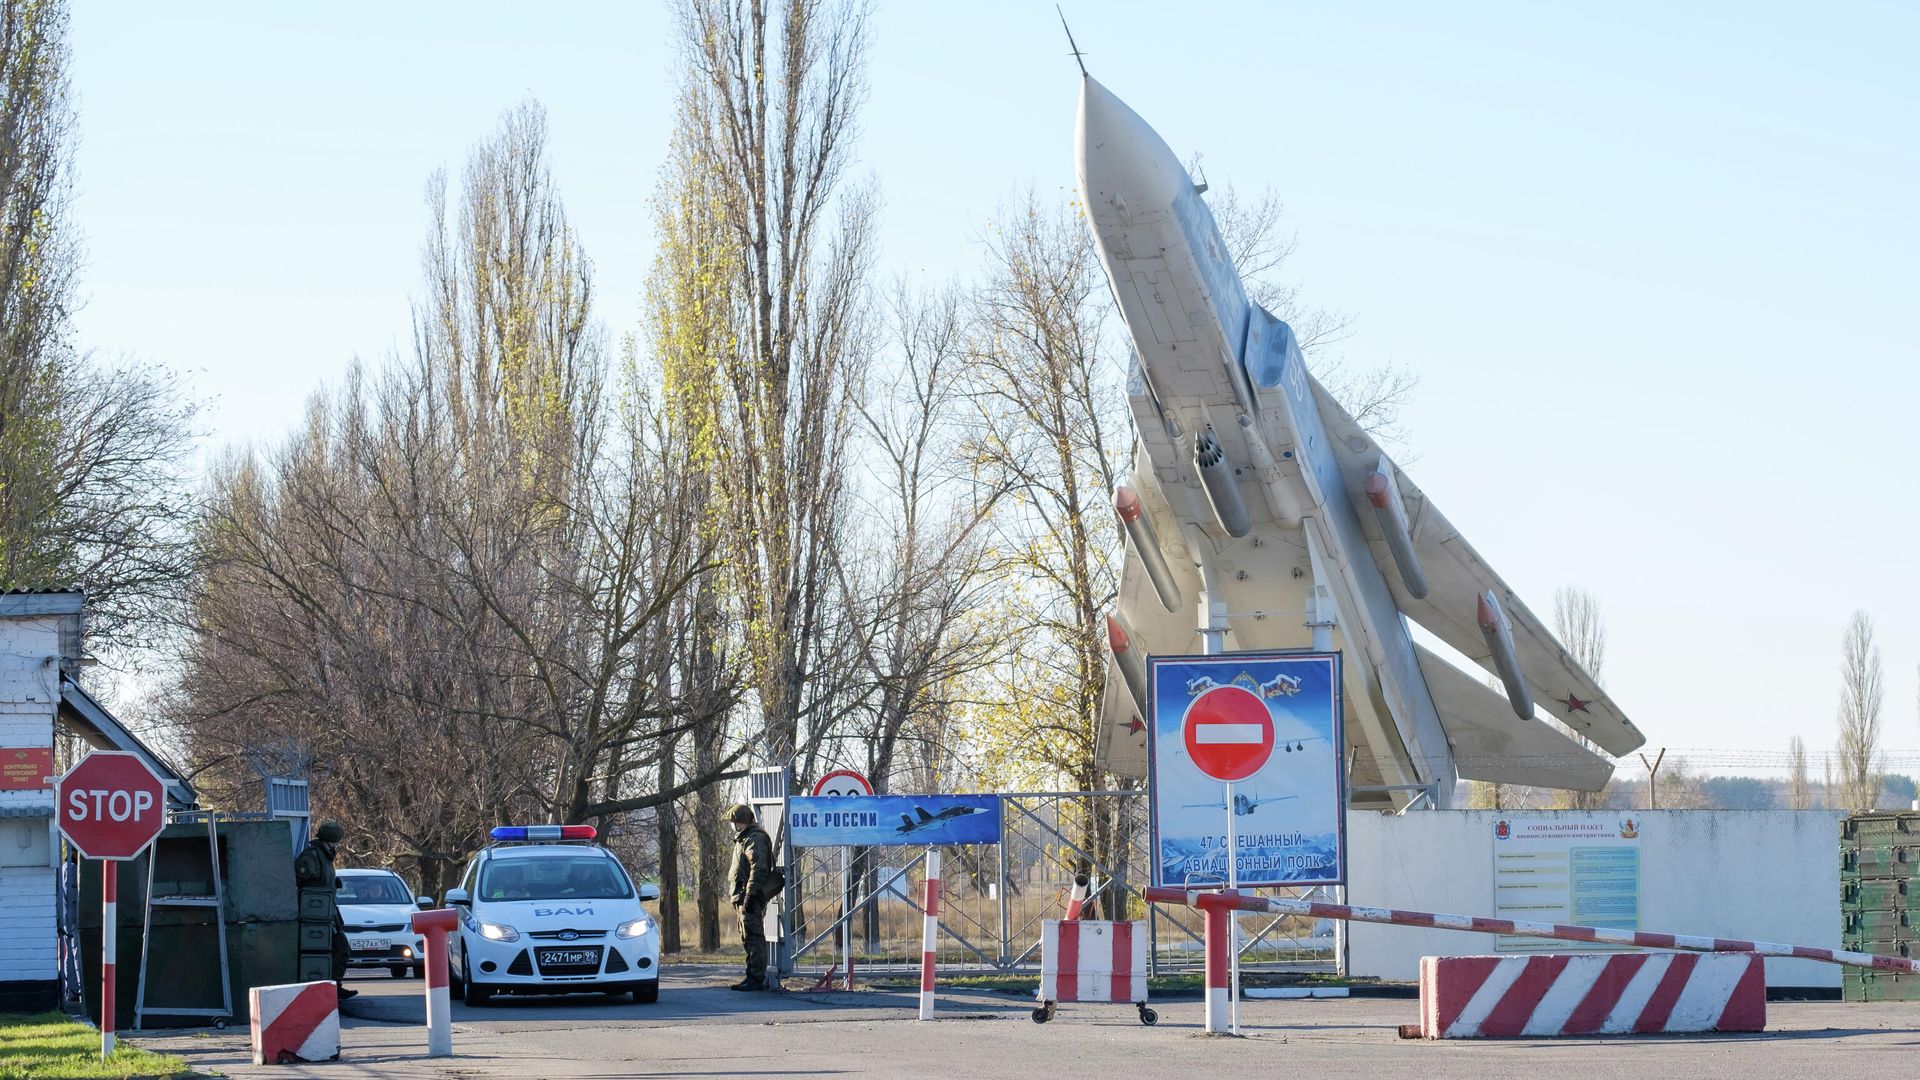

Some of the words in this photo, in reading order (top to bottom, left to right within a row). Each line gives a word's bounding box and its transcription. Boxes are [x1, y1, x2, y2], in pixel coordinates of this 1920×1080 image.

[68, 788, 154, 822] STOP
[792, 813, 818, 828] ВКС
[824, 812, 877, 827] РОССИИ
[1527, 823, 1579, 832] СОЦИАЛЬНЫЙ
[1580, 823, 1604, 831] ПАКЕТ
[1200, 836, 1213, 849] 47
[1220, 830, 1302, 848] СЕШАННЫЙ
[1184, 853, 1281, 873] АВИАЦОННЫЙ
[1287, 854, 1320, 869] ПОЛК
[534, 907, 594, 917] ВАИ
[544, 952, 583, 963] 2471МР
[584, 951, 595, 960] 99
